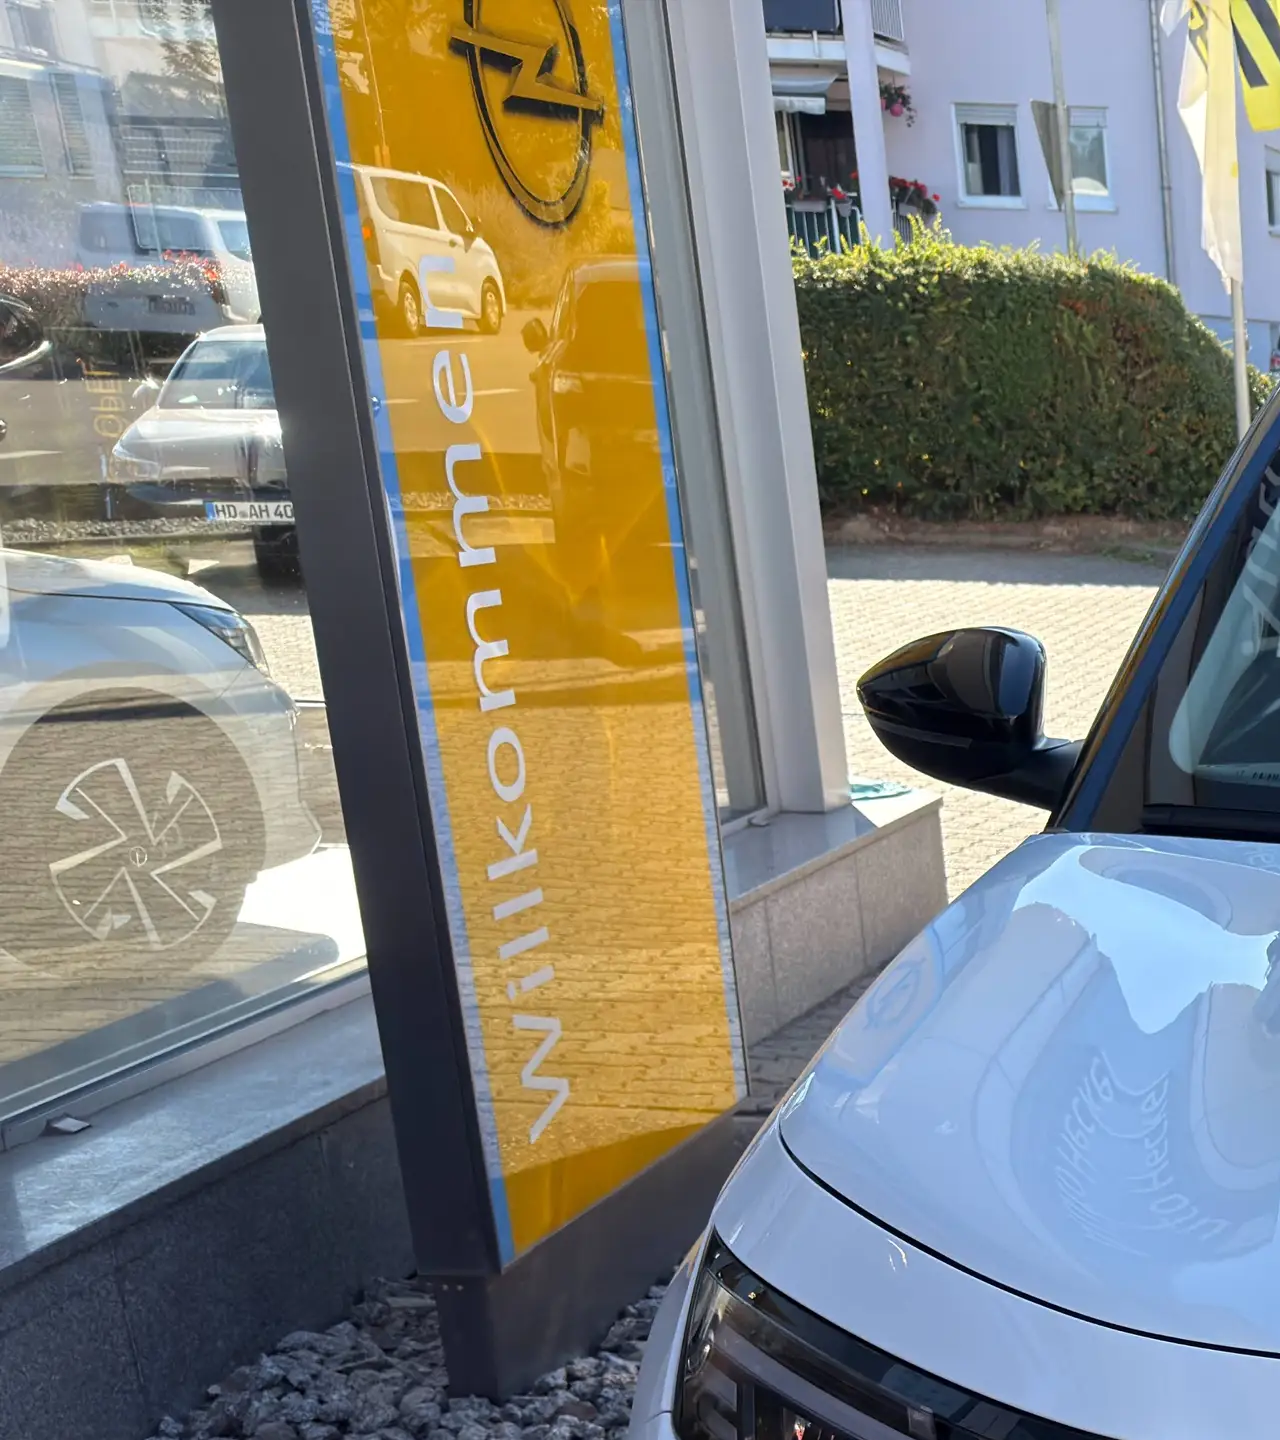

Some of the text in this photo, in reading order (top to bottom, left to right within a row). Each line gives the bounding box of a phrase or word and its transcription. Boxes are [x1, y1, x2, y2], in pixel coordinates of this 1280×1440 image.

[215, 504, 237, 518] HD
[249, 504, 270, 518] AH
[418, 252, 571, 1146] Willkommen
